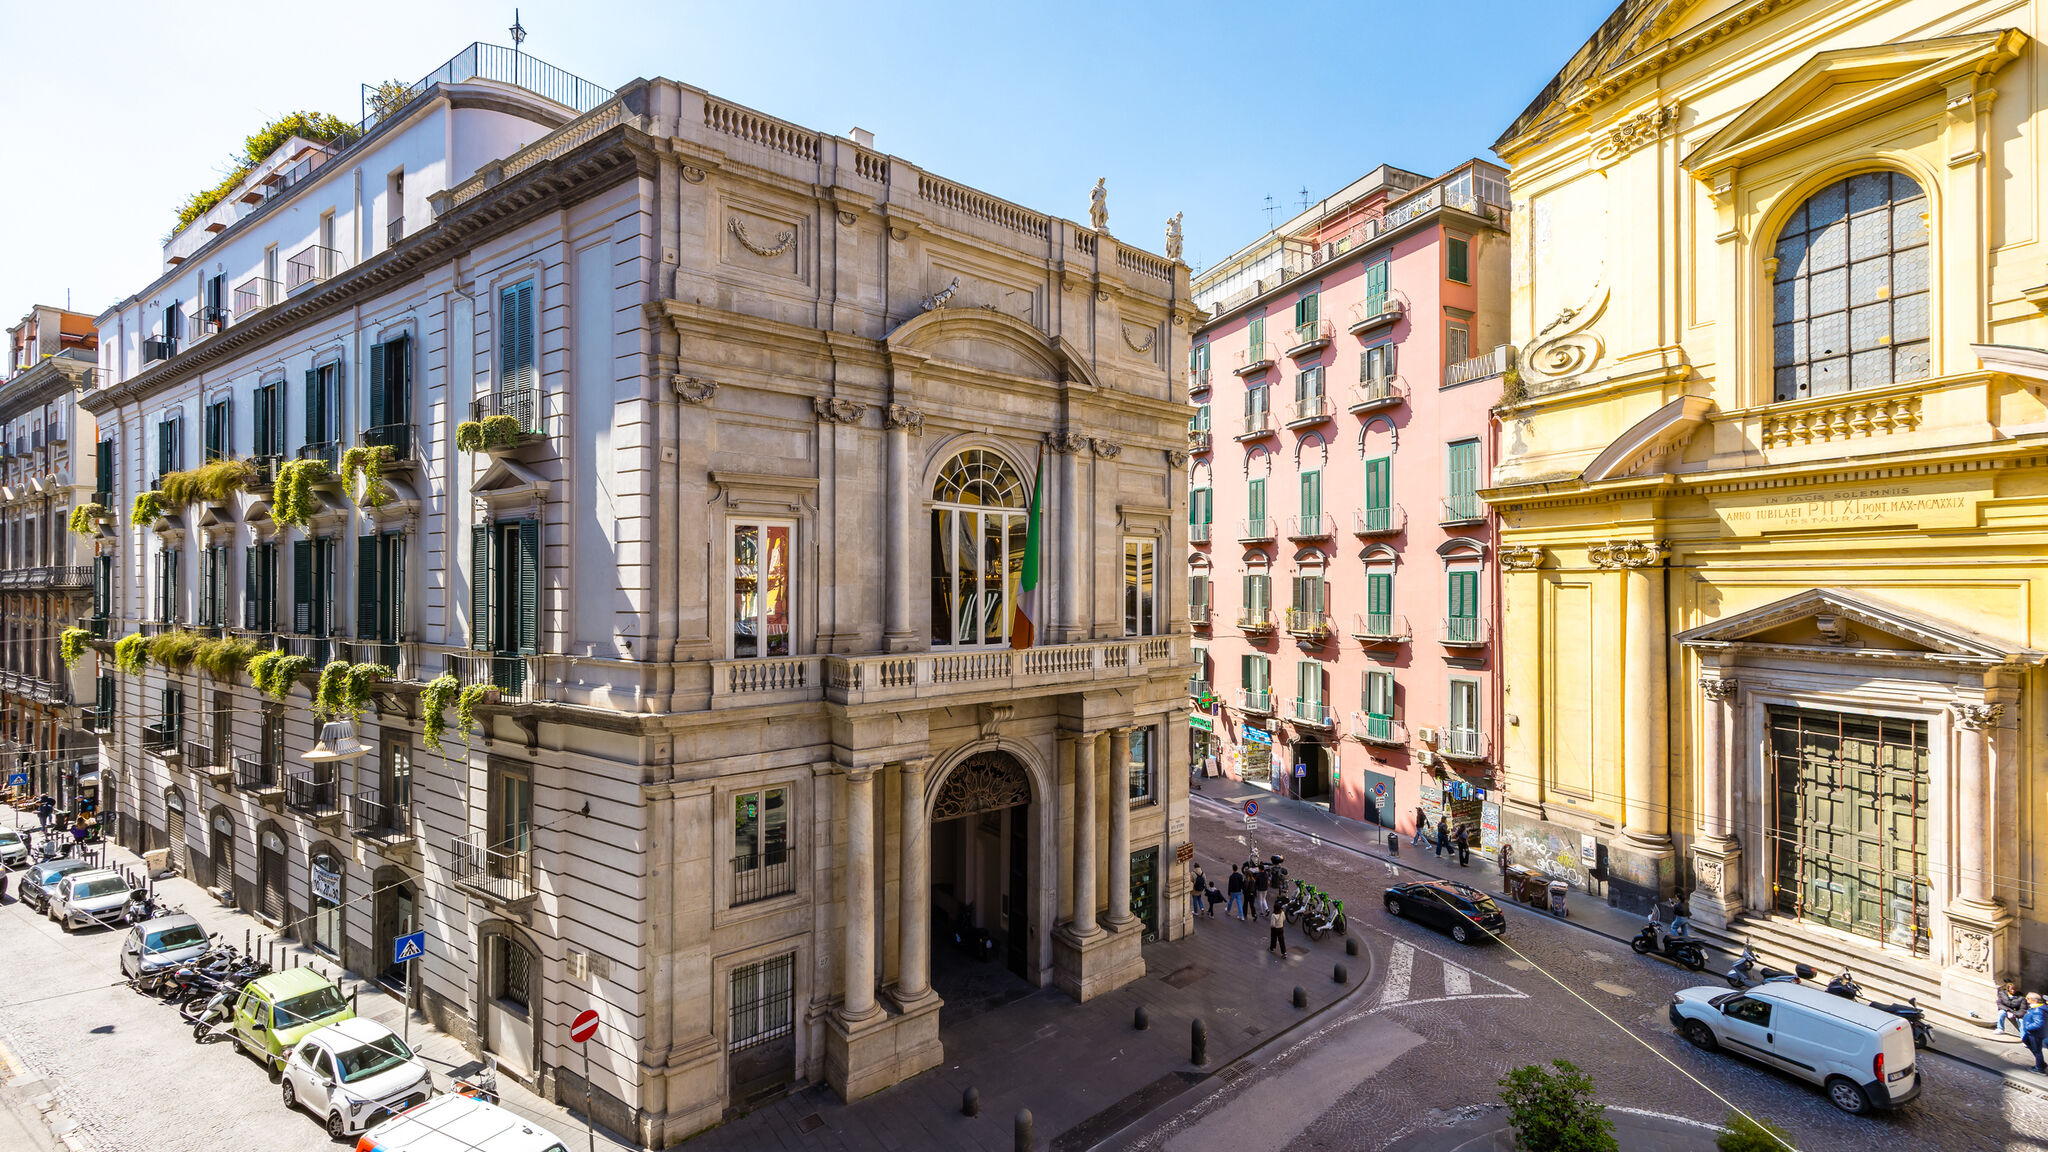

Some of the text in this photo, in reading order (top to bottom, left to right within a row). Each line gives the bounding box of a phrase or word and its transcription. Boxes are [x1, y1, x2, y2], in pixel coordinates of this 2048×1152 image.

[1834, 488, 1910, 499] SOLEMNIIS
[1726, 511, 1751, 521] ANNO
[1808, 501, 1833, 516] PII
[1843, 499, 1859, 514] XI
